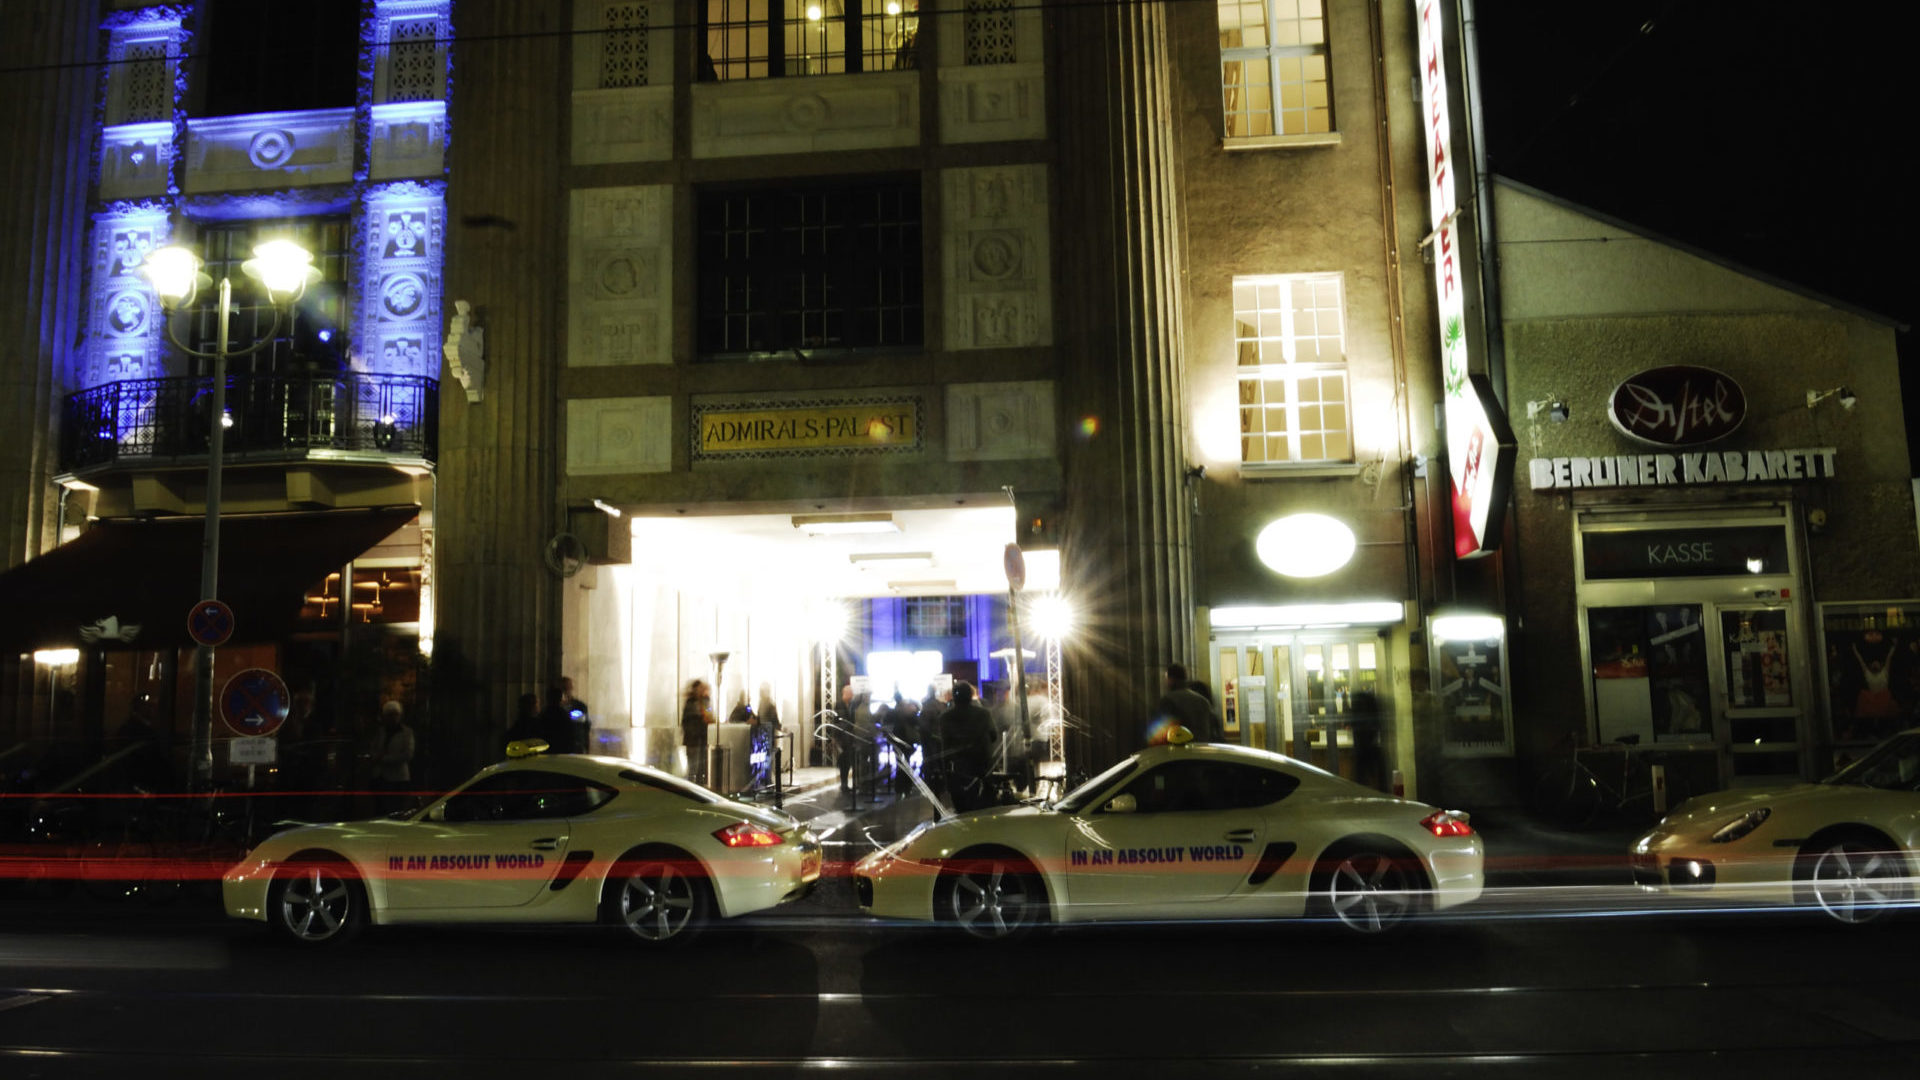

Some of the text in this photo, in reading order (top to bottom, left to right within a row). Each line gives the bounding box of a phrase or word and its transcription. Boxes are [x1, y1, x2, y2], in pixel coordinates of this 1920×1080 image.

[1529, 447, 1838, 490] BERLINER KABARETT
[1647, 542, 1714, 564] KASSE
[389, 854, 545, 870] IN AN ABSOLUT WORLD
[1071, 845, 1244, 866] IN AN ABSOLUT WORLD
